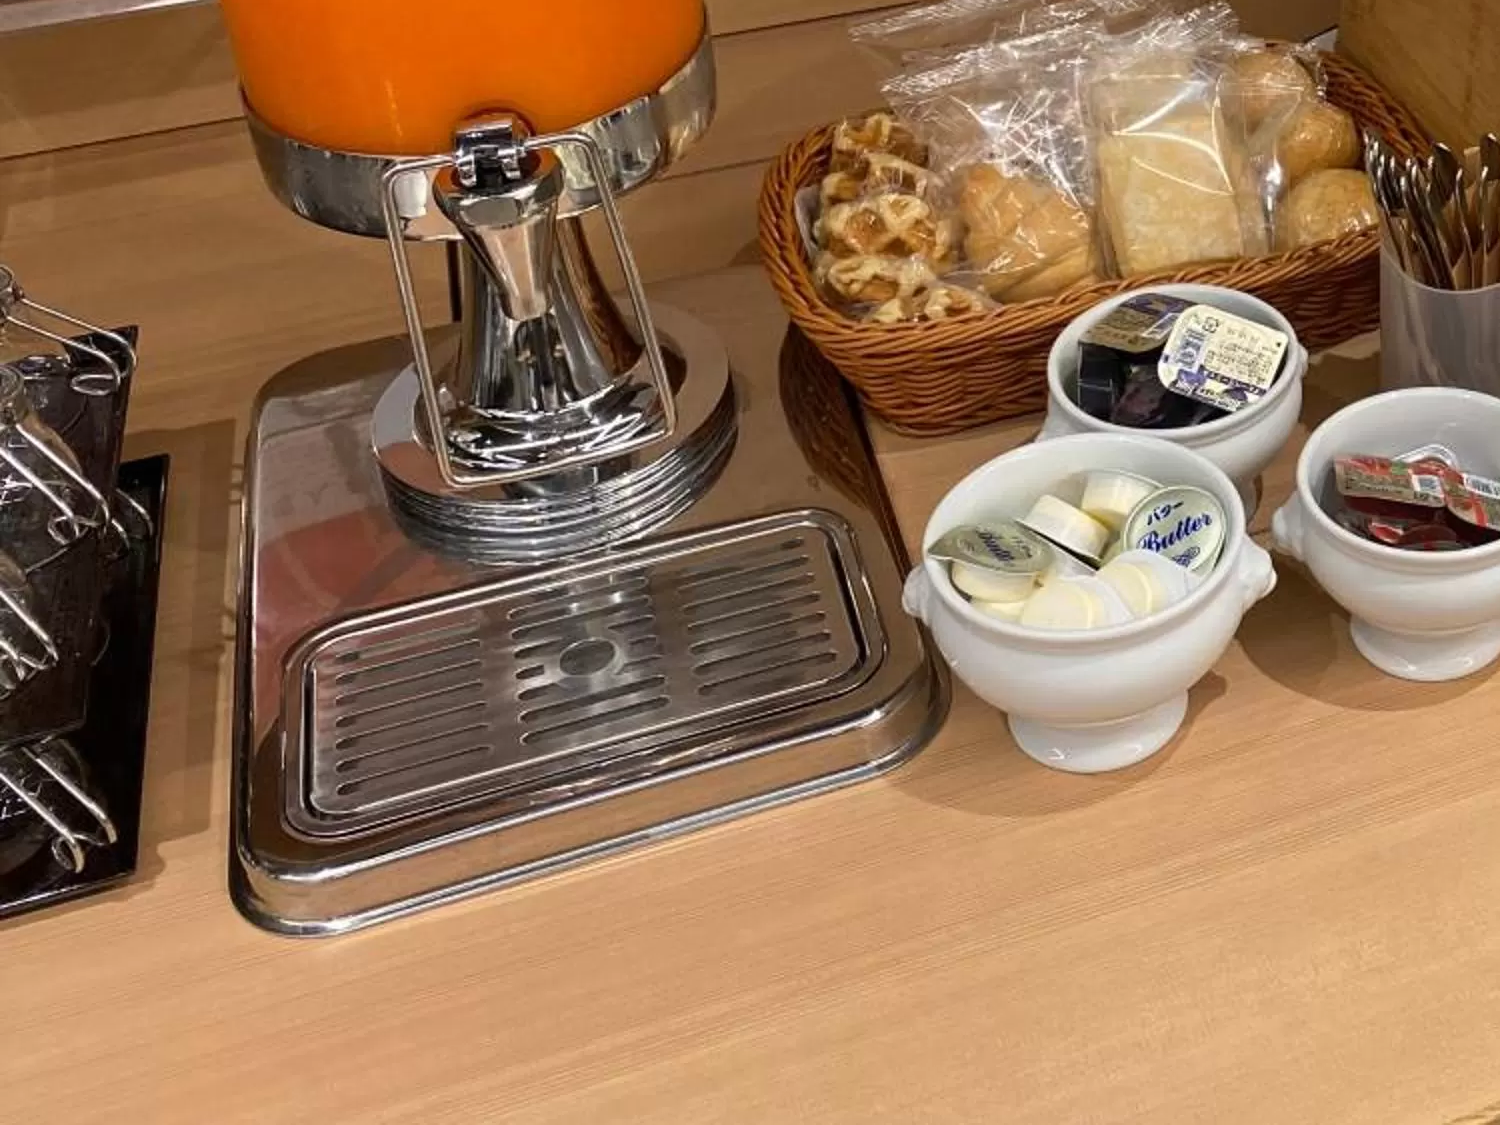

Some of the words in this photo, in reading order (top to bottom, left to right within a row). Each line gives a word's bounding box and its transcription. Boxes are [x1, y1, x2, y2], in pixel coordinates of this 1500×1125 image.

[1147, 500, 1185, 526] バター
[1136, 512, 1213, 553] Butter
